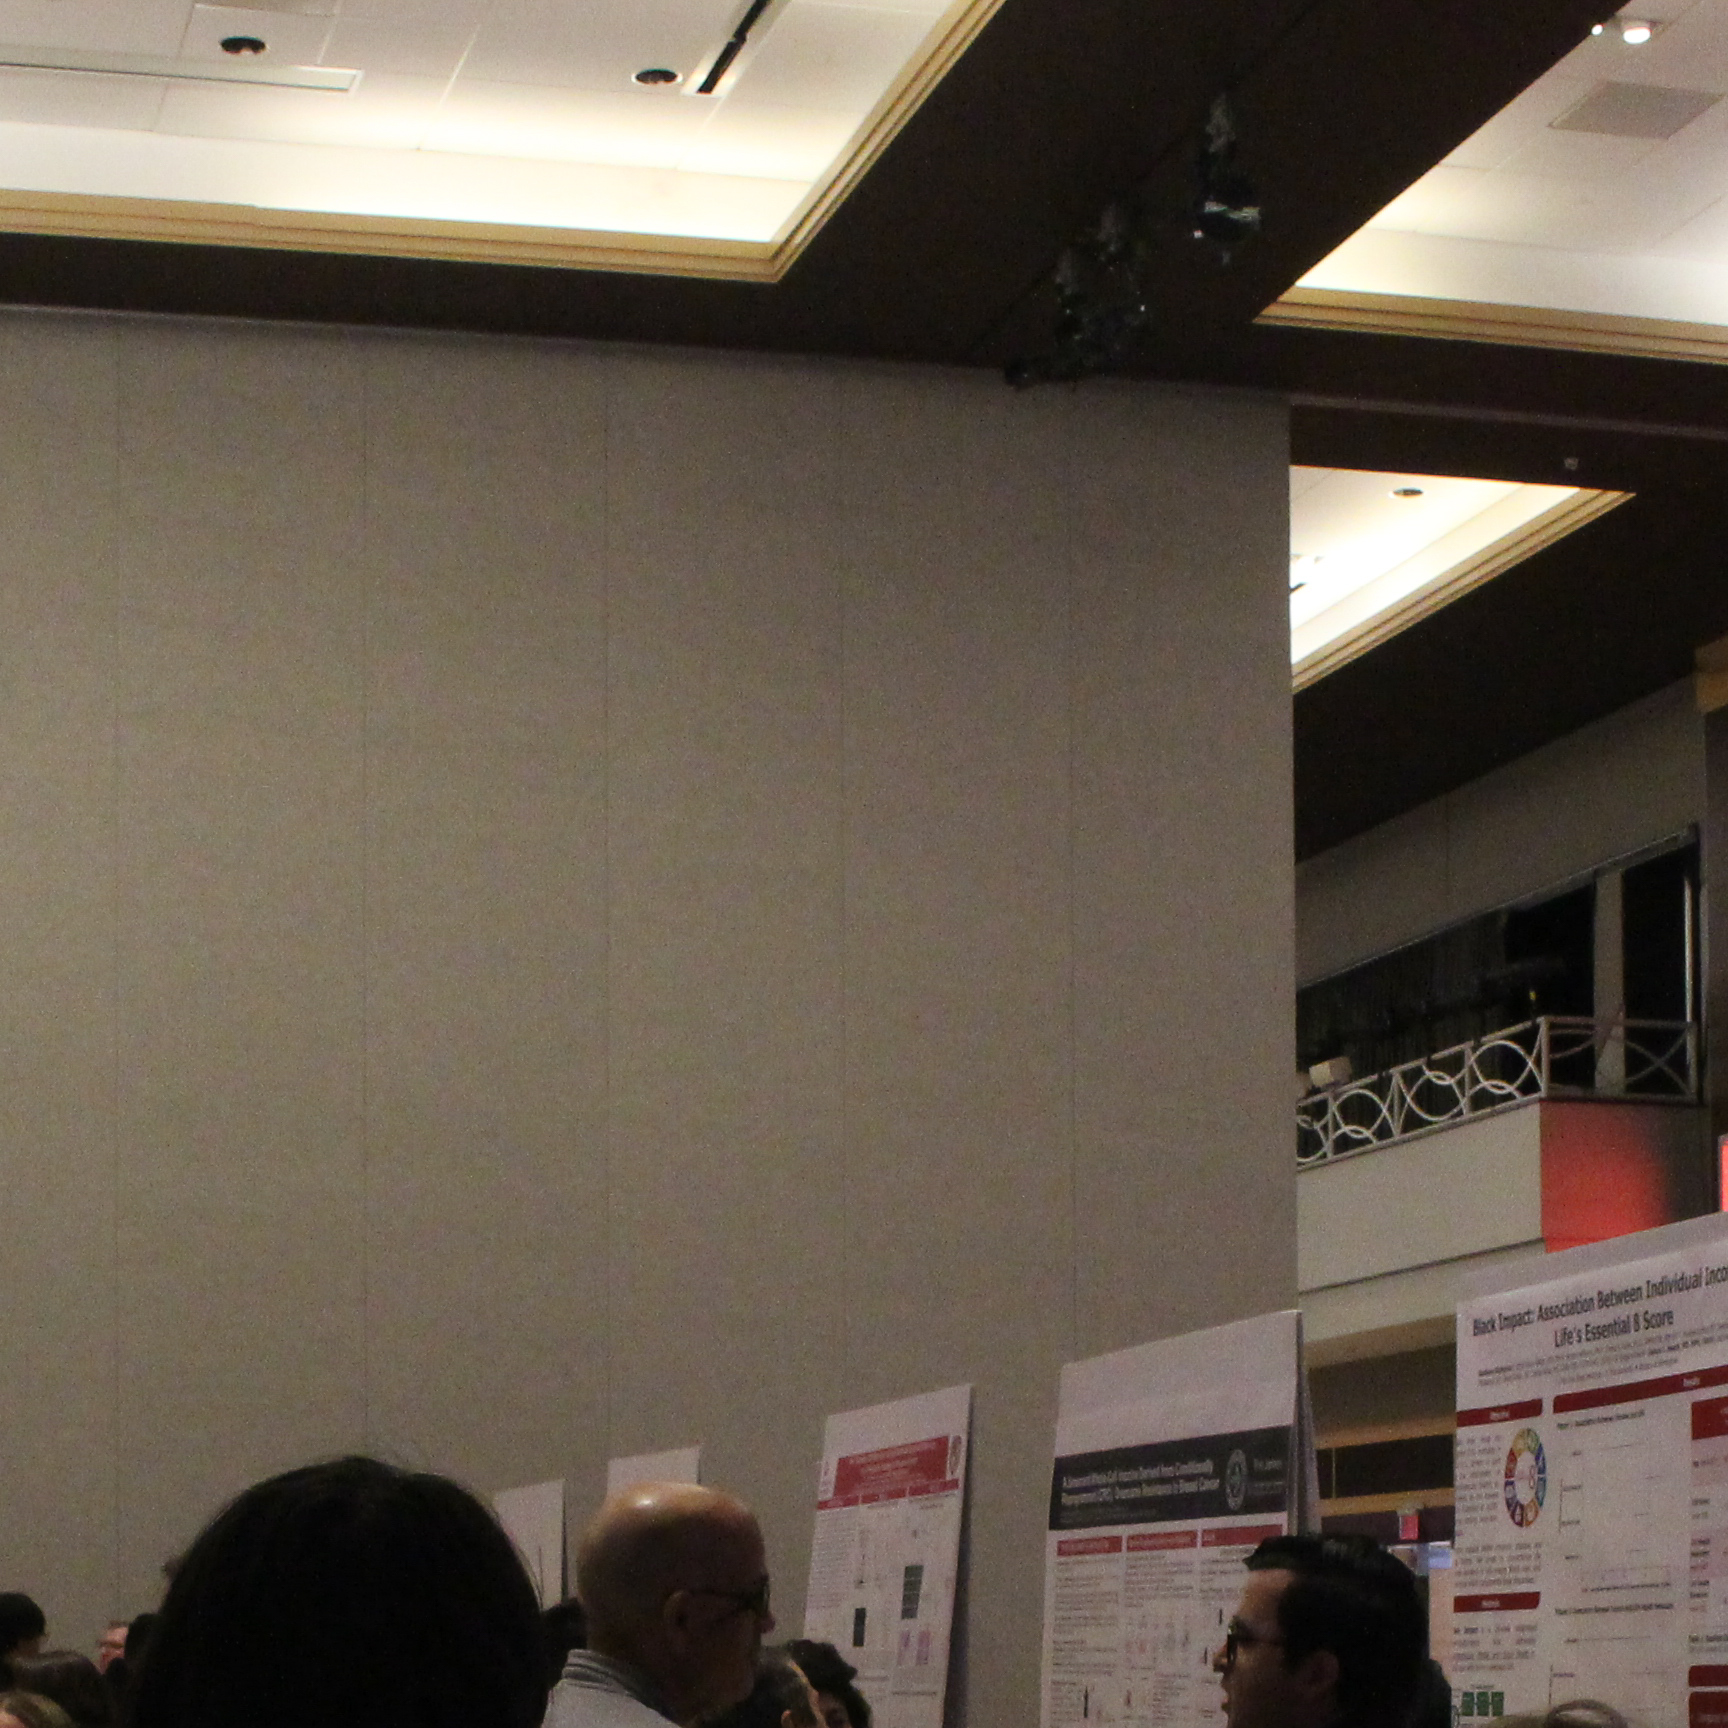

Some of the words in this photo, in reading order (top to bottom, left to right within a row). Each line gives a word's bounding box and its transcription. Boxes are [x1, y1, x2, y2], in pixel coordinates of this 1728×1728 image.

[1472, 1315, 1496, 1338] Black
[1498, 1308, 1537, 1333] Impact:
[1537, 1296, 1594, 1323] Association
[1597, 1286, 1643, 1311] Between
[1646, 1268, 1703, 1298] Individual
[1554, 1326, 1583, 1349] Life's
[1584, 1315, 1630, 1342] Essential
[1643, 1310, 1674, 1330] Score
